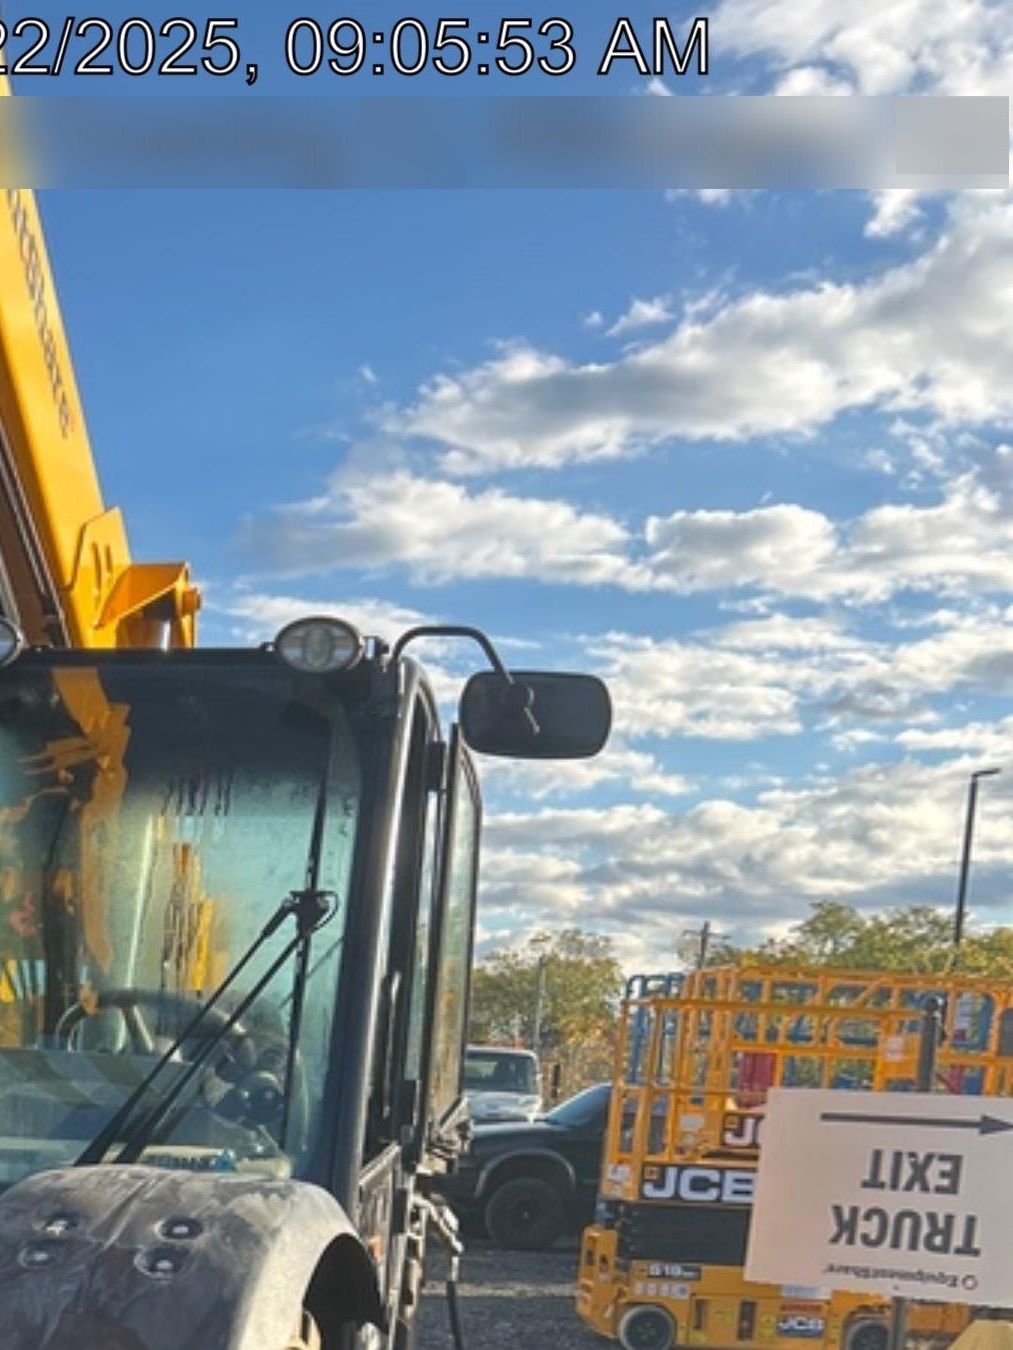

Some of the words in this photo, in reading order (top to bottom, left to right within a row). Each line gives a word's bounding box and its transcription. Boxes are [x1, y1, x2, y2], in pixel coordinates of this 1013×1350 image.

[860, 1149, 964, 1195] EXIT
[829, 1205, 981, 1257] TRUCK
[778, 1314, 825, 1331] JCB
